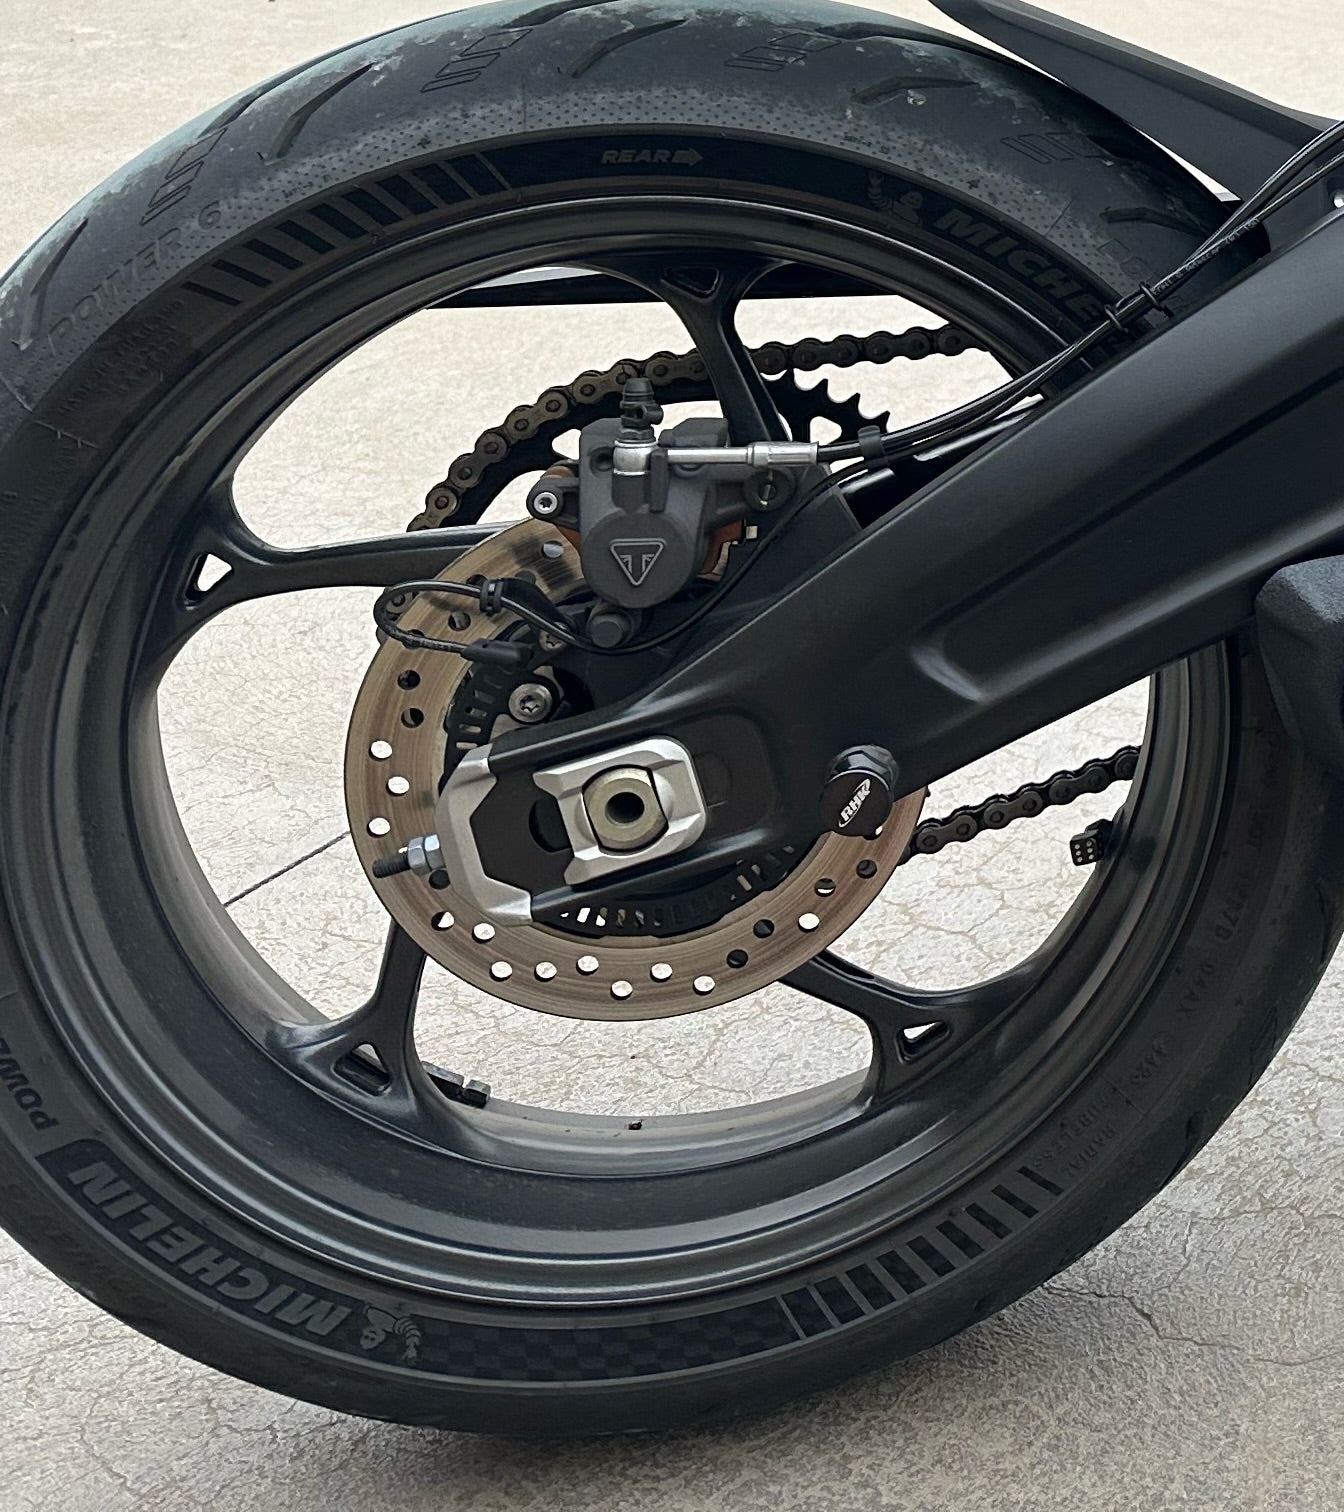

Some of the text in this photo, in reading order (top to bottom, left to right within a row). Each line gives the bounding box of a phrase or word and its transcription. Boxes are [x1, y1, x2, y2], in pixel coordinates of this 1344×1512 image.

[600, 148, 672, 165] REAR
[934, 207, 1103, 324] MICHE
[839, 784, 871, 822] RHK
[67, 1160, 352, 1336] MICHELIN
